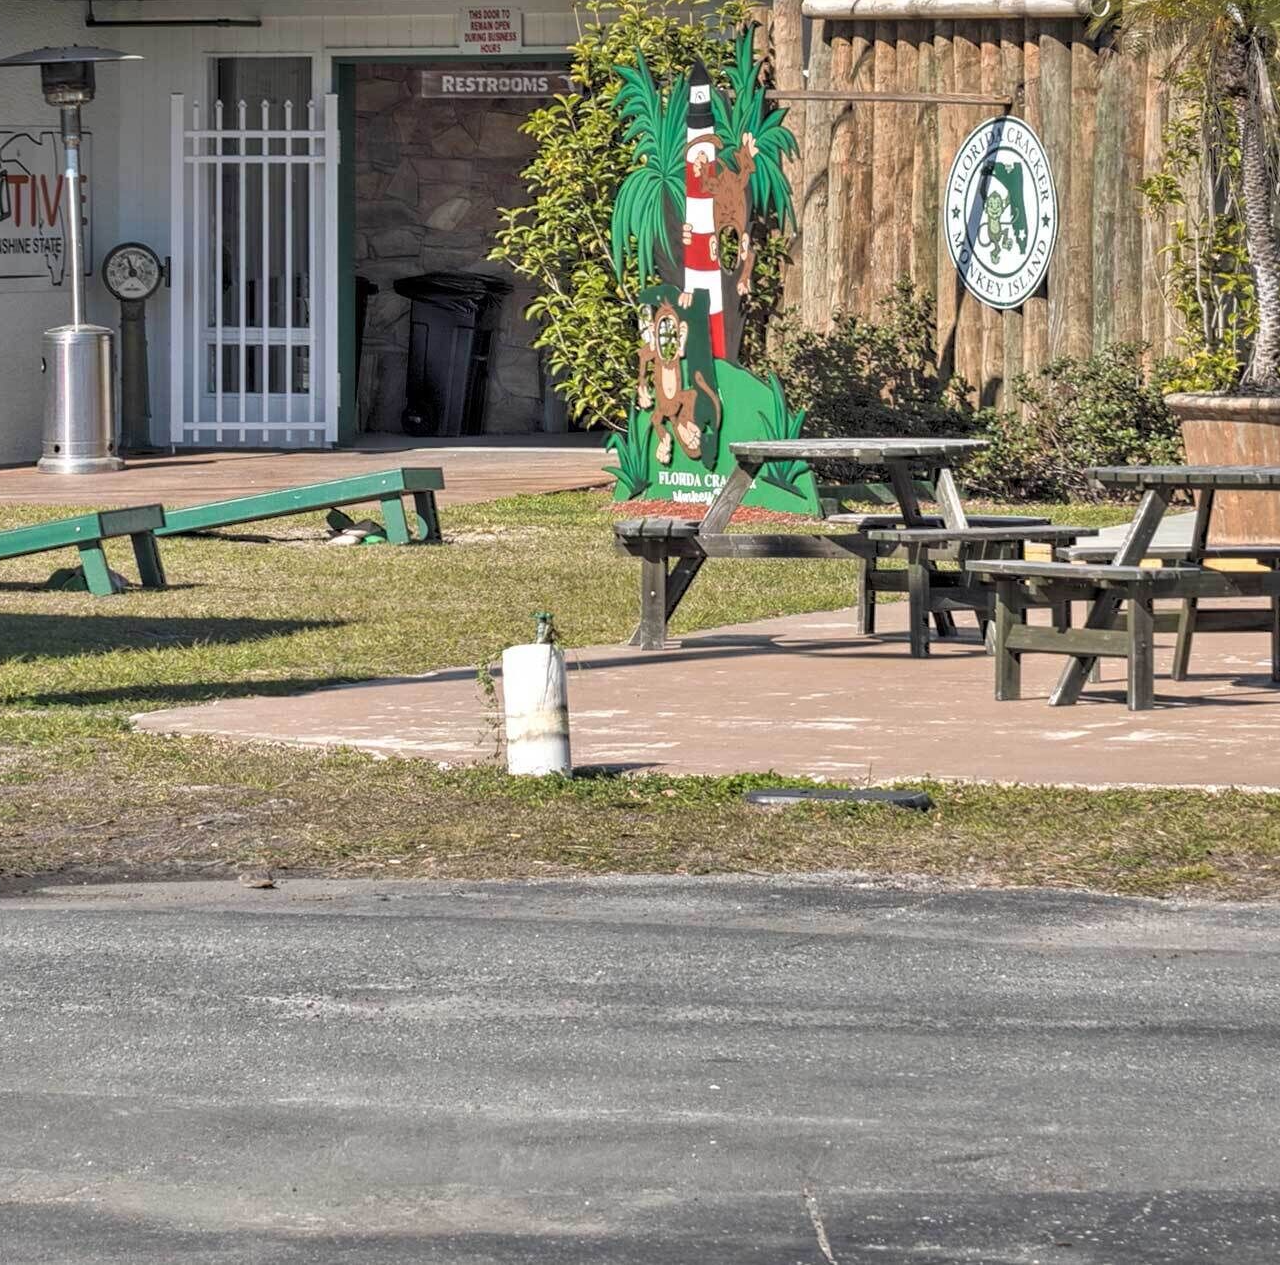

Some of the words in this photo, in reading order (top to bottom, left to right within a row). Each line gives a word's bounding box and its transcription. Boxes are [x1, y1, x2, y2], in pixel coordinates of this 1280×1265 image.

[483, 9, 500, 20] DOOR
[501, 9, 511, 20] TO
[470, 21, 493, 31] REMAIN
[494, 20, 511, 31] OPEN
[464, 32, 486, 43] DURING
[487, 31, 517, 42] BUSINESS
[480, 44, 501, 53] HOURS
[441, 75, 549, 93] RESTROOMS
[953, 128, 1004, 195] FLORIDA
[1006, 126, 1050, 201] CRACKER
[33, 236, 63, 254] STATE
[952, 230, 1005, 298] MONKEY
[1008, 238, 1048, 298] ISLAND
